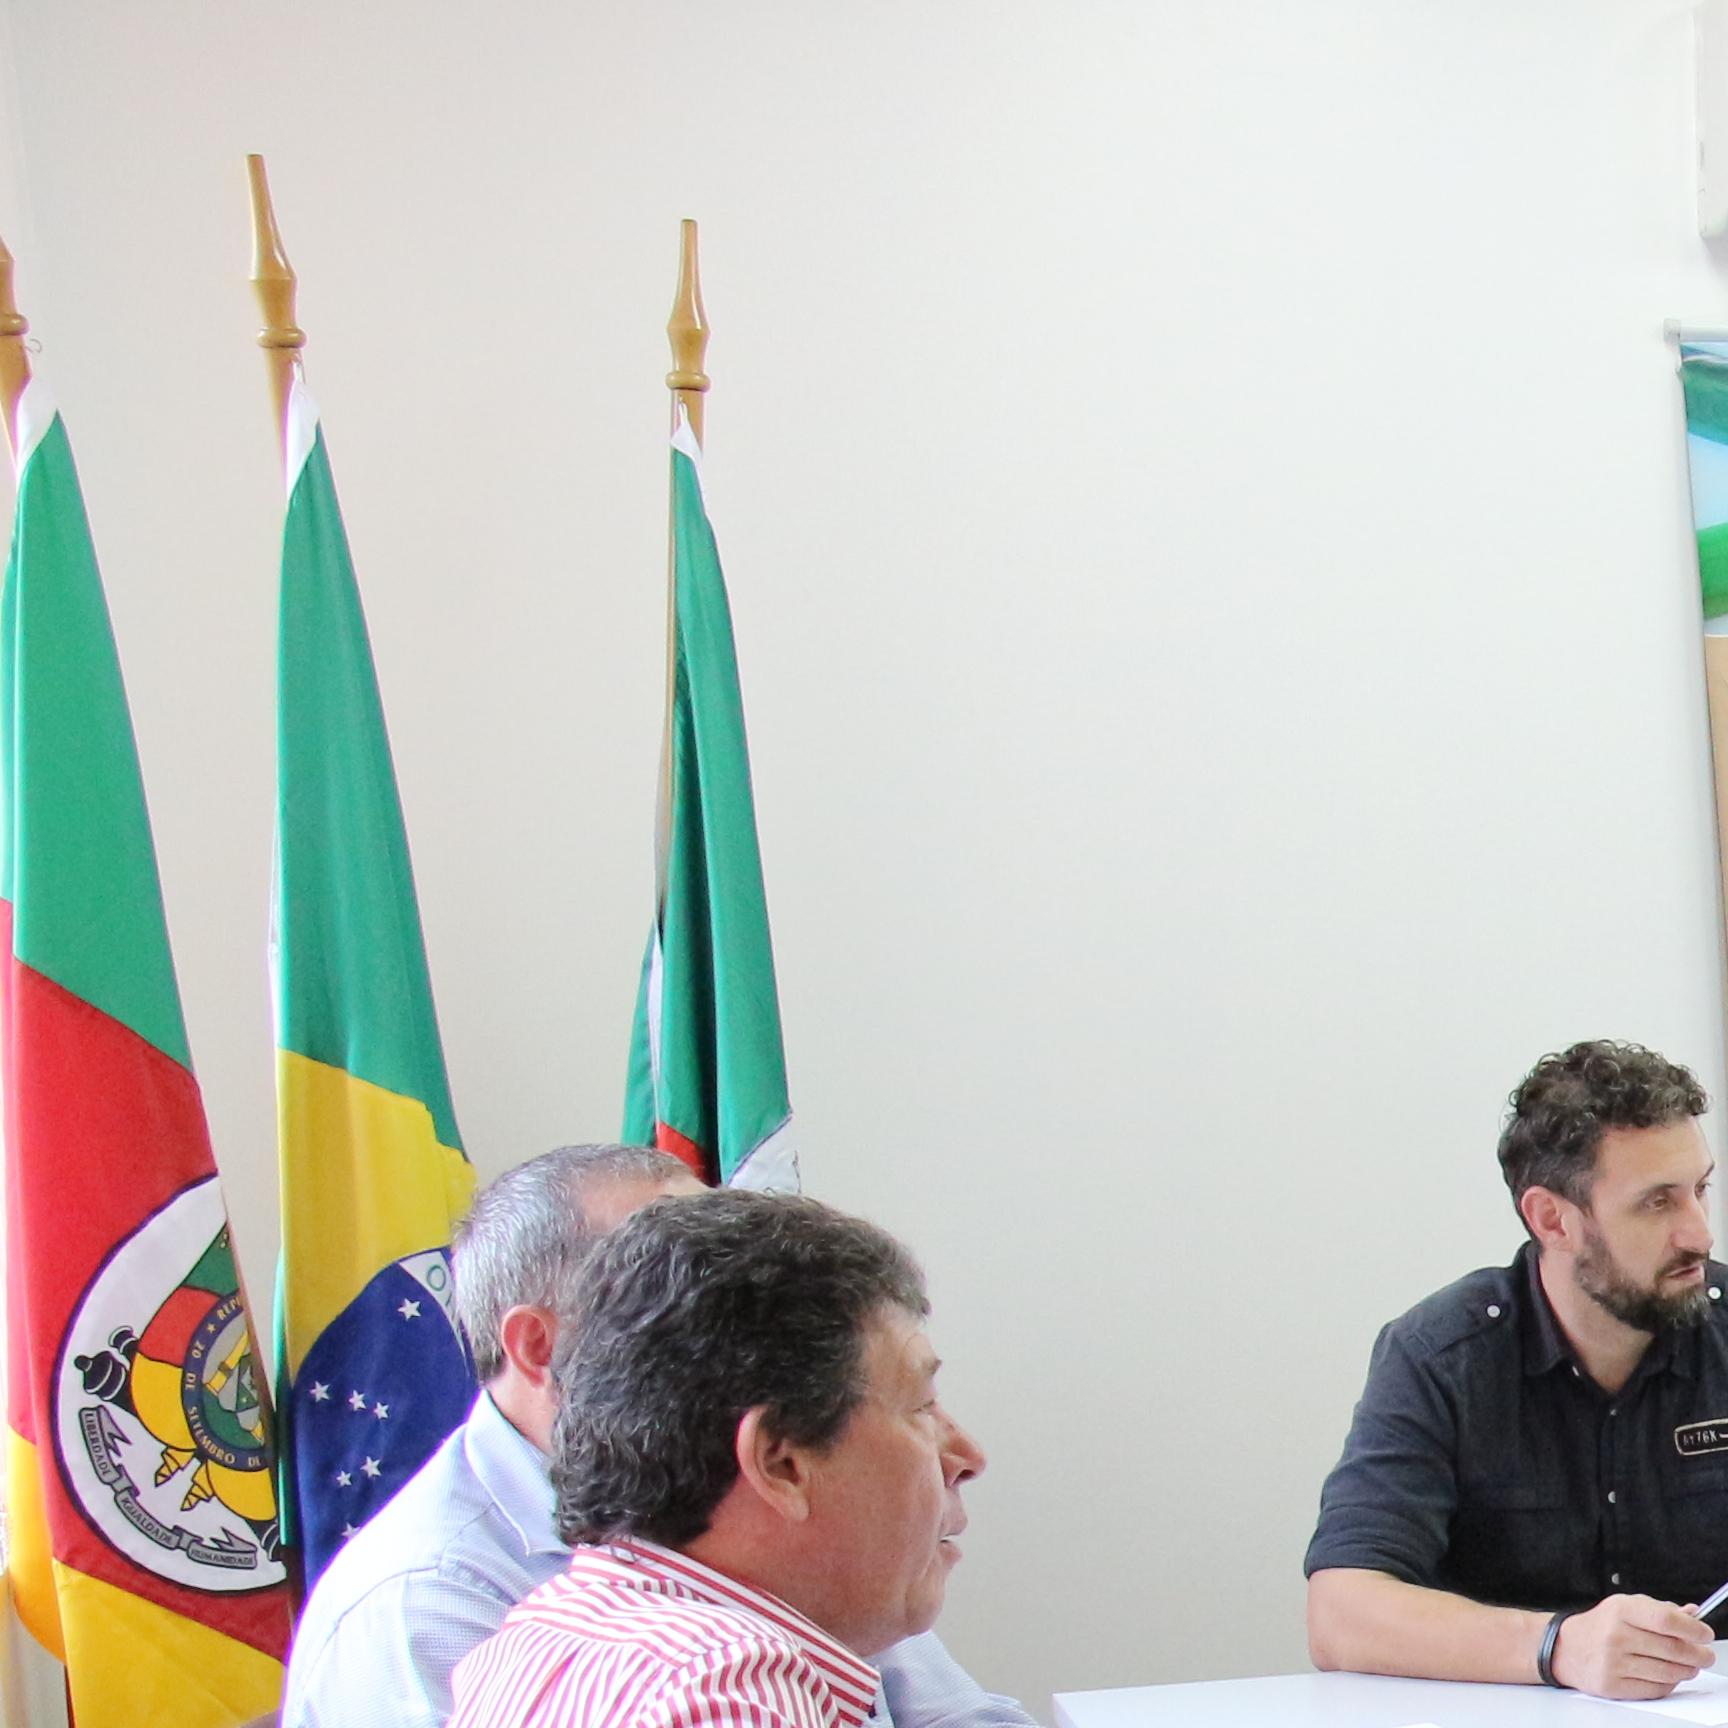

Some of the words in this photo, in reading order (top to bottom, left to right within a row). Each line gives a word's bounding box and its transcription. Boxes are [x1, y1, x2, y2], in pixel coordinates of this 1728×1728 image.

[84, 1412, 113, 1477] LIBERDADE
[187, 1406, 236, 1465] SETEMBRO
[121, 1497, 174, 1545] IGUALDADE
[190, 1549, 254, 1567] HUMANIDADE
